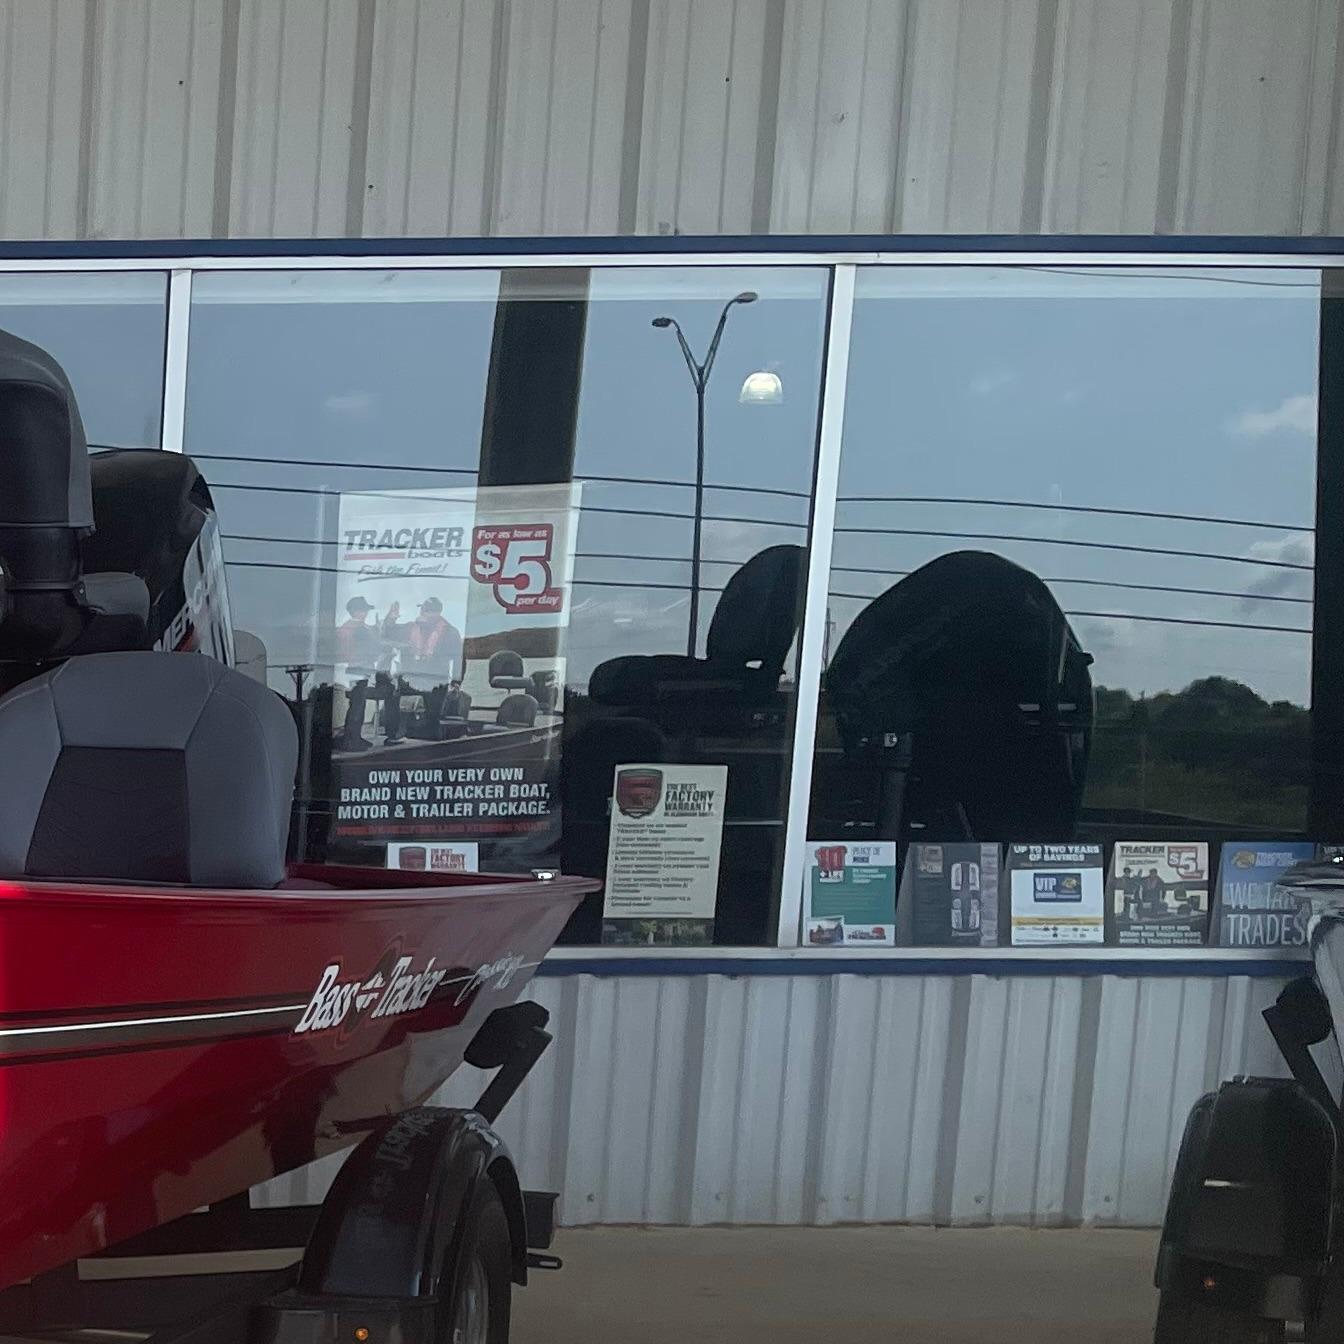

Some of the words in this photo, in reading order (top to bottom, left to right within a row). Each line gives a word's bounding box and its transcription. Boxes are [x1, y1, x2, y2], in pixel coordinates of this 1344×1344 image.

[344, 527, 464, 551] TRACKER
[478, 530, 495, 539] For
[498, 530, 511, 539] as
[534, 529, 548, 537] as
[407, 549, 464, 560] boats
[475, 540, 548, 605] $5
[516, 597, 534, 607] per
[537, 595, 560, 606] day
[369, 770, 400, 784] OWN
[406, 769, 443, 783] YOUR
[448, 768, 485, 782] VERY
[490, 768, 524, 781] OWN
[341, 788, 391, 802] BRAND
[396, 787, 430, 800] NEW
[434, 785, 504, 799] TRACKER
[510, 784, 550, 799] BOAT,
[665, 790, 715, 802] FACTORY
[338, 804, 389, 819] MOTOR
[394, 804, 405, 818] &
[411, 802, 473, 817] TRAILER
[478, 801, 551, 816] PACKAGE.
[664, 802, 713, 811] WARRANTY
[1068, 845, 1100, 853] YEARS
[1120, 846, 1165, 854] TRACKER
[1035, 877, 1057, 891] VIP
[1229, 882, 1258, 910] WE
[1226, 914, 1306, 946] TRADES
[295, 964, 361, 1034] Bass
[371, 956, 447, 1019] Tracker
